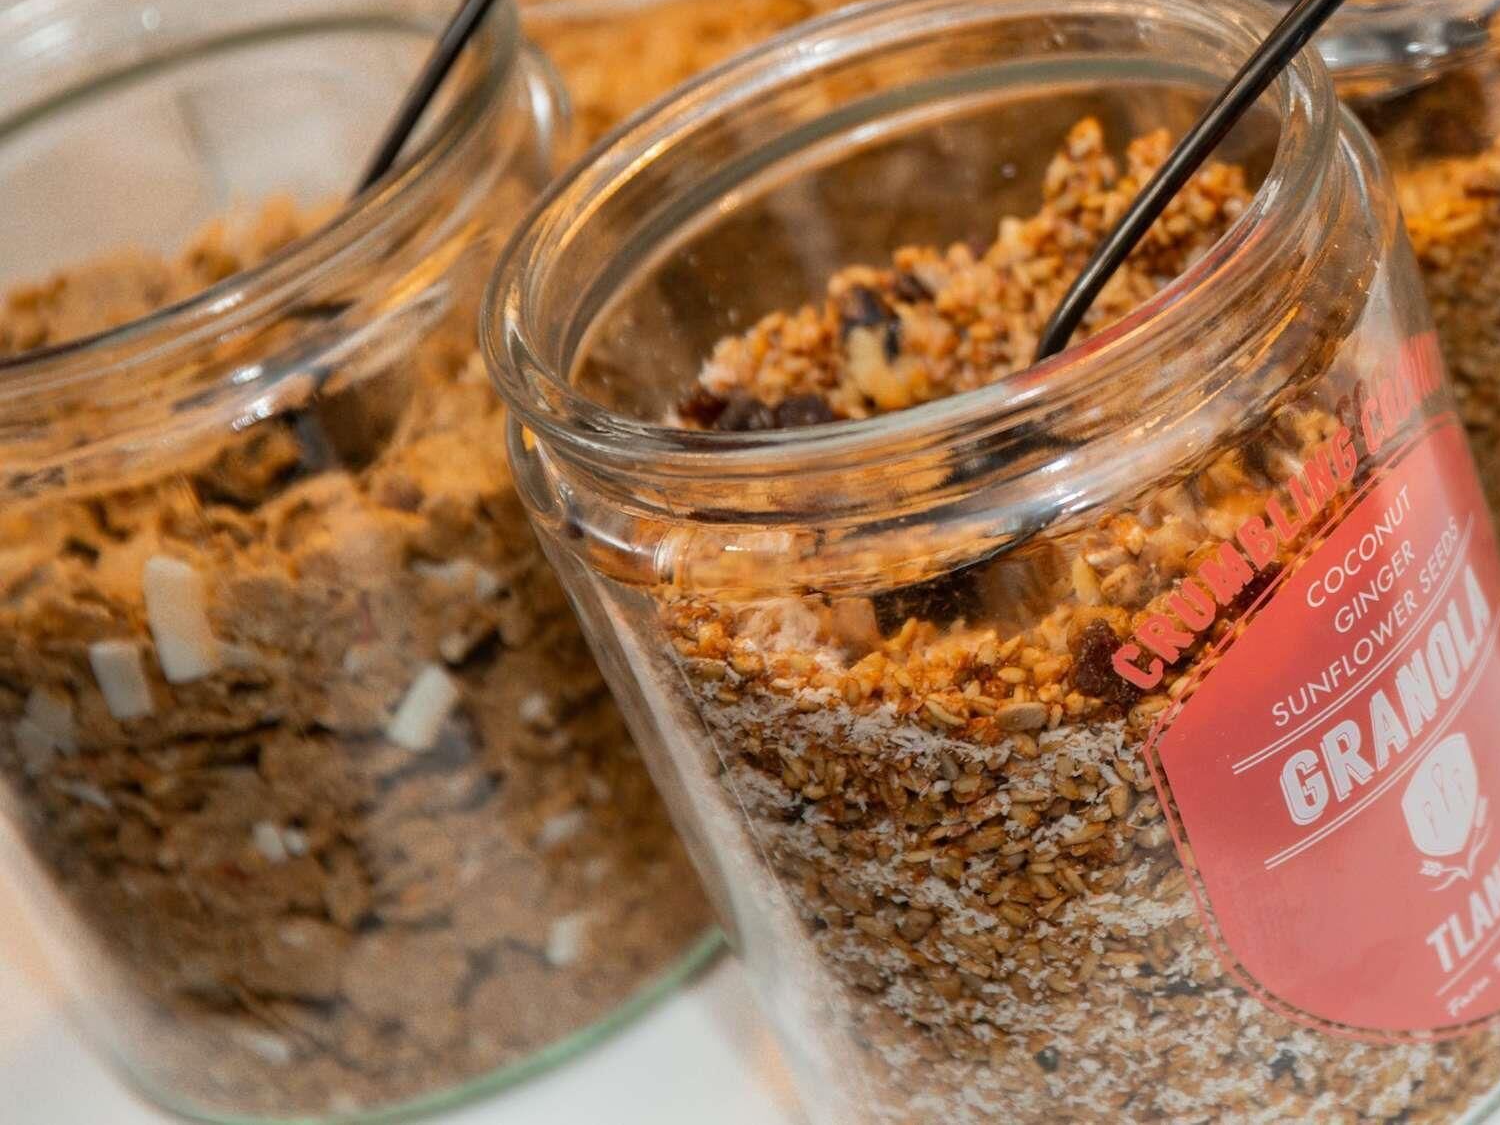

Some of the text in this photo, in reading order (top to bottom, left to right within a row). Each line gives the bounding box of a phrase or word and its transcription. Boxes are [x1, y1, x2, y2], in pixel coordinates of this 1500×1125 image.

[1111, 426, 1358, 689] CRUMBLING
[1272, 516, 1460, 726] SUNFLOWER SEEDS
[1306, 485, 1411, 608] COCONUT
[1334, 540, 1415, 633] GINGER
[1280, 565, 1490, 826] GRANOLA
